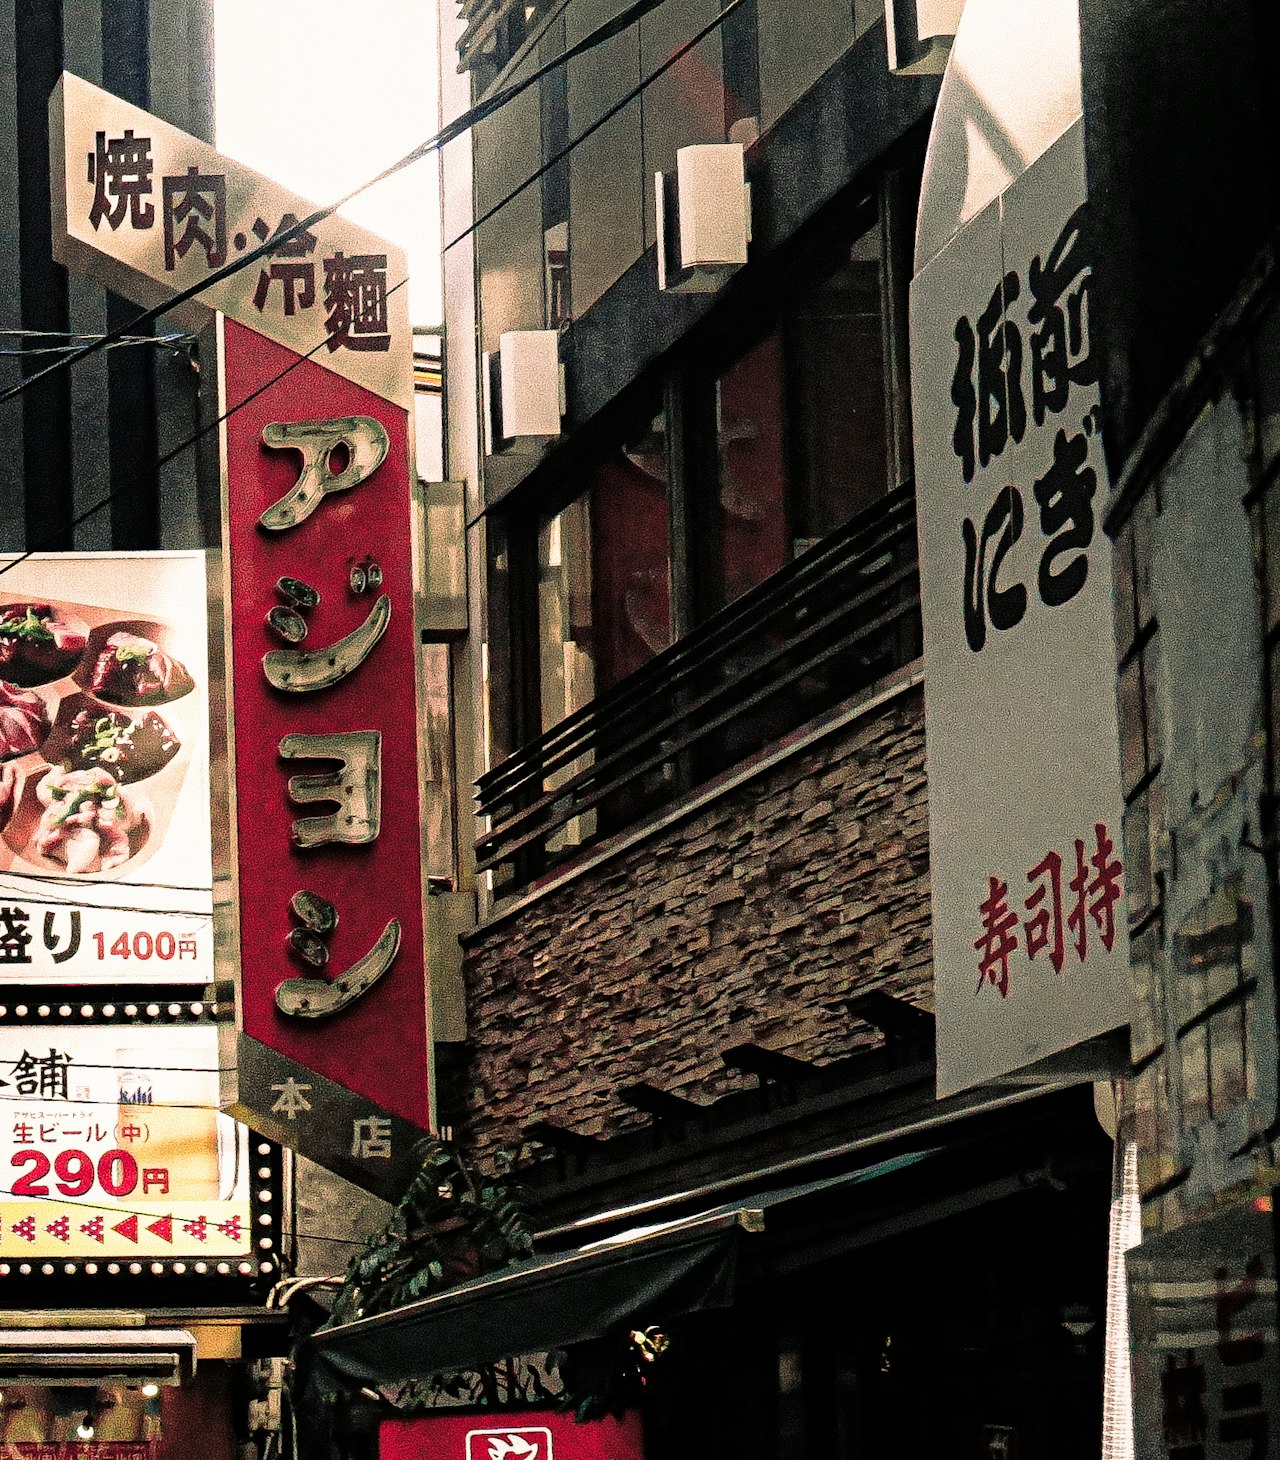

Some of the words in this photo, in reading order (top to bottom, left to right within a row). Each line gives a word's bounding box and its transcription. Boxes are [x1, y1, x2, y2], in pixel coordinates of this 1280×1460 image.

[92, 931, 198, 961] 1400円
[271, 1077, 393, 1159] 本店
[11, 1149, 170, 1197] 290円
